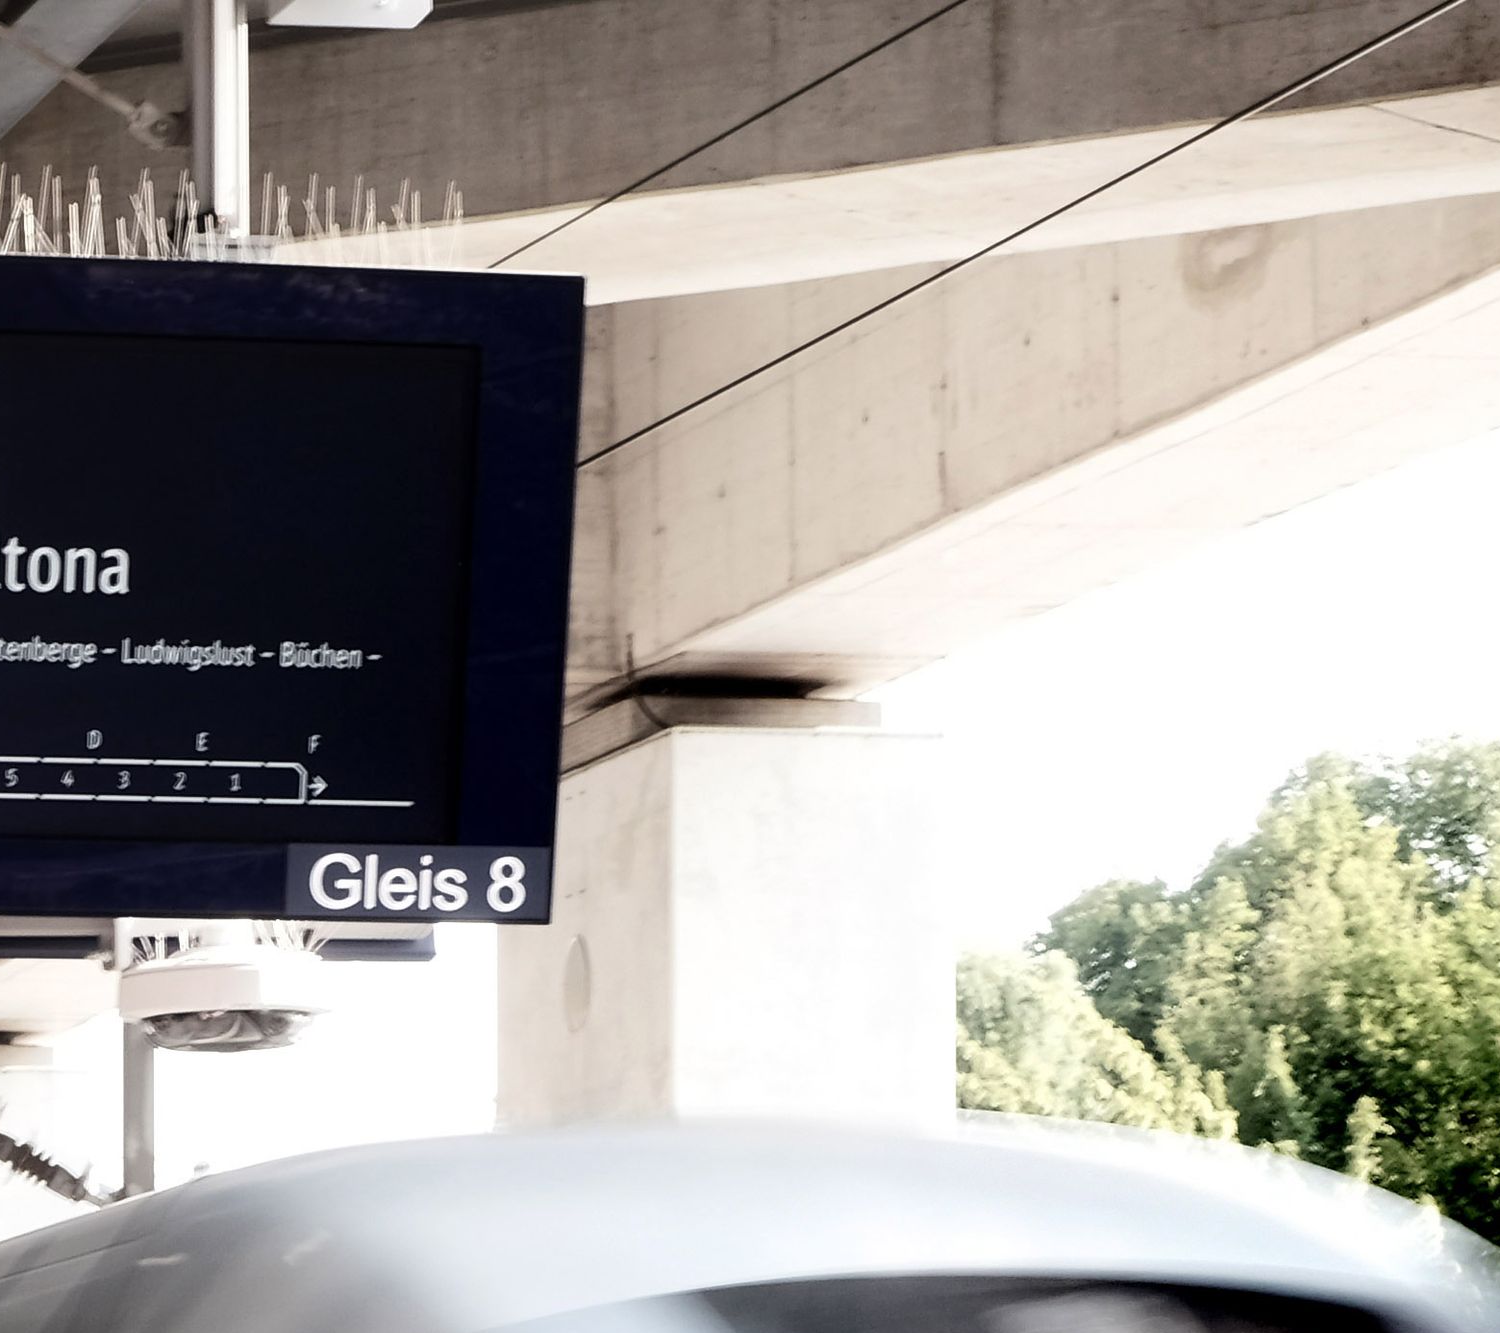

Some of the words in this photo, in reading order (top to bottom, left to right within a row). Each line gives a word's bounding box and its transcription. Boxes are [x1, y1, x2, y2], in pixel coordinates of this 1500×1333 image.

[121, 638, 256, 670] Ludwigslust
[279, 641, 362, 669] Büchen
[85, 729, 103, 750] D
[195, 732, 210, 752] E
[307, 734, 323, 754] F
[4, 768, 20, 787] 5
[60, 769, 75, 787] 4
[117, 771, 131, 789] 3
[173, 772, 188, 790] 2
[228, 773, 241, 792] 1
[309, 853, 469, 912] Gleis
[486, 856, 527, 912] 8
